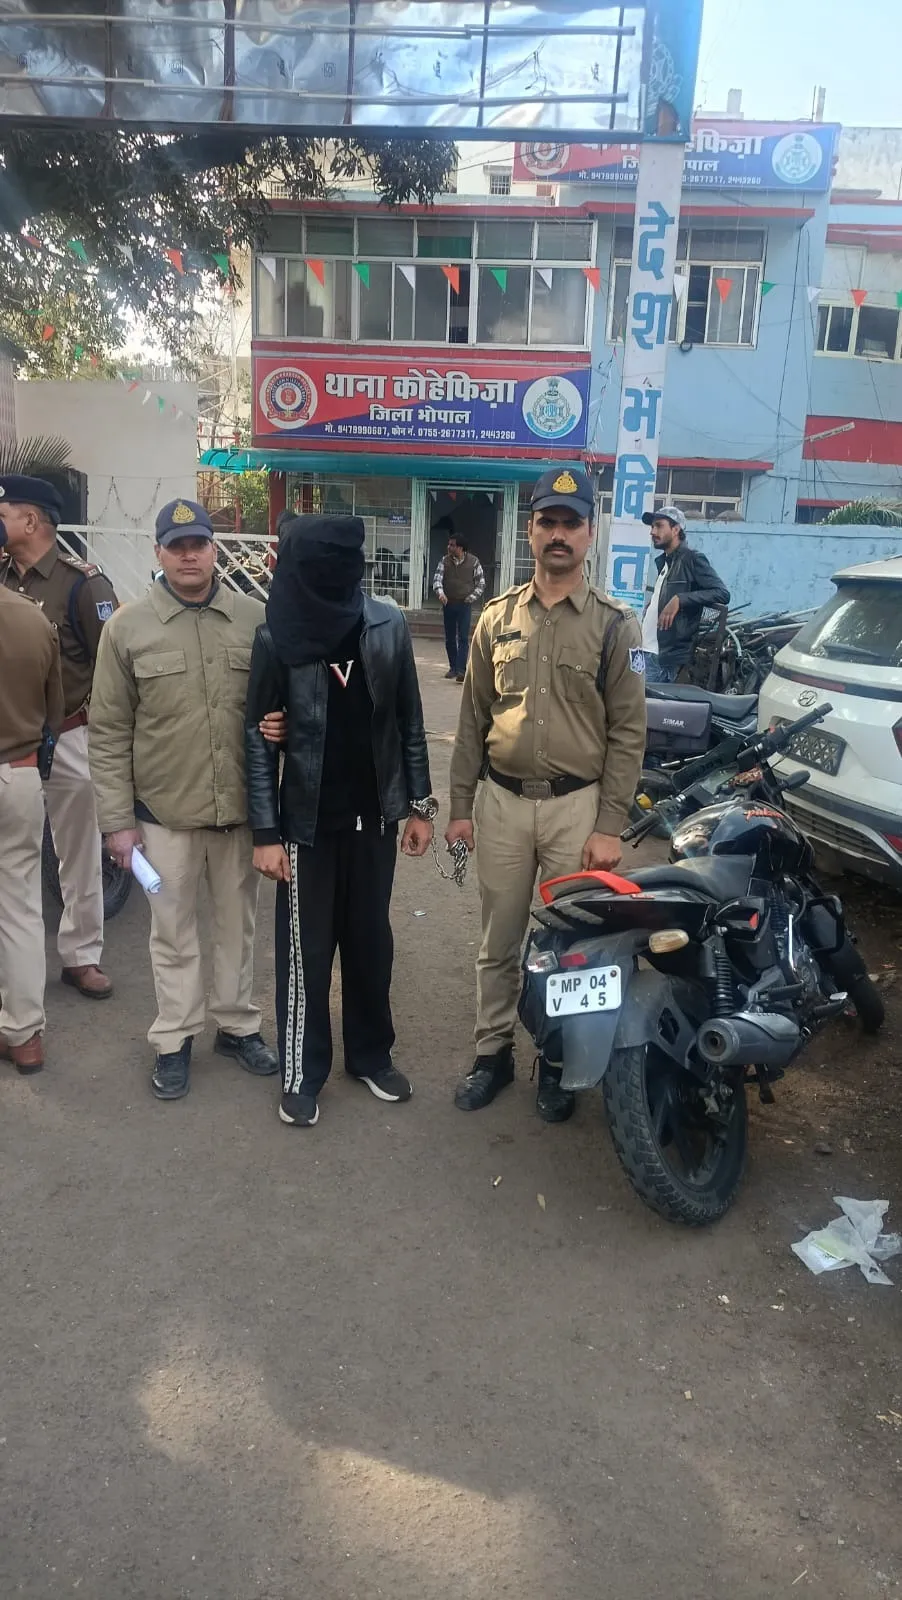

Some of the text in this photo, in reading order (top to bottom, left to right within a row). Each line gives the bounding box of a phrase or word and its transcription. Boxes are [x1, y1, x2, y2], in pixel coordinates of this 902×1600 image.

[325, 373, 387, 399] थाना
[392, 368, 518, 409] कोहेफिज़ा
[369, 404, 471, 424] जिला भोपाल
[330, 659, 355, 689] V
[561, 974, 607, 994] MP 04
[552, 991, 607, 1012] V 4 5
